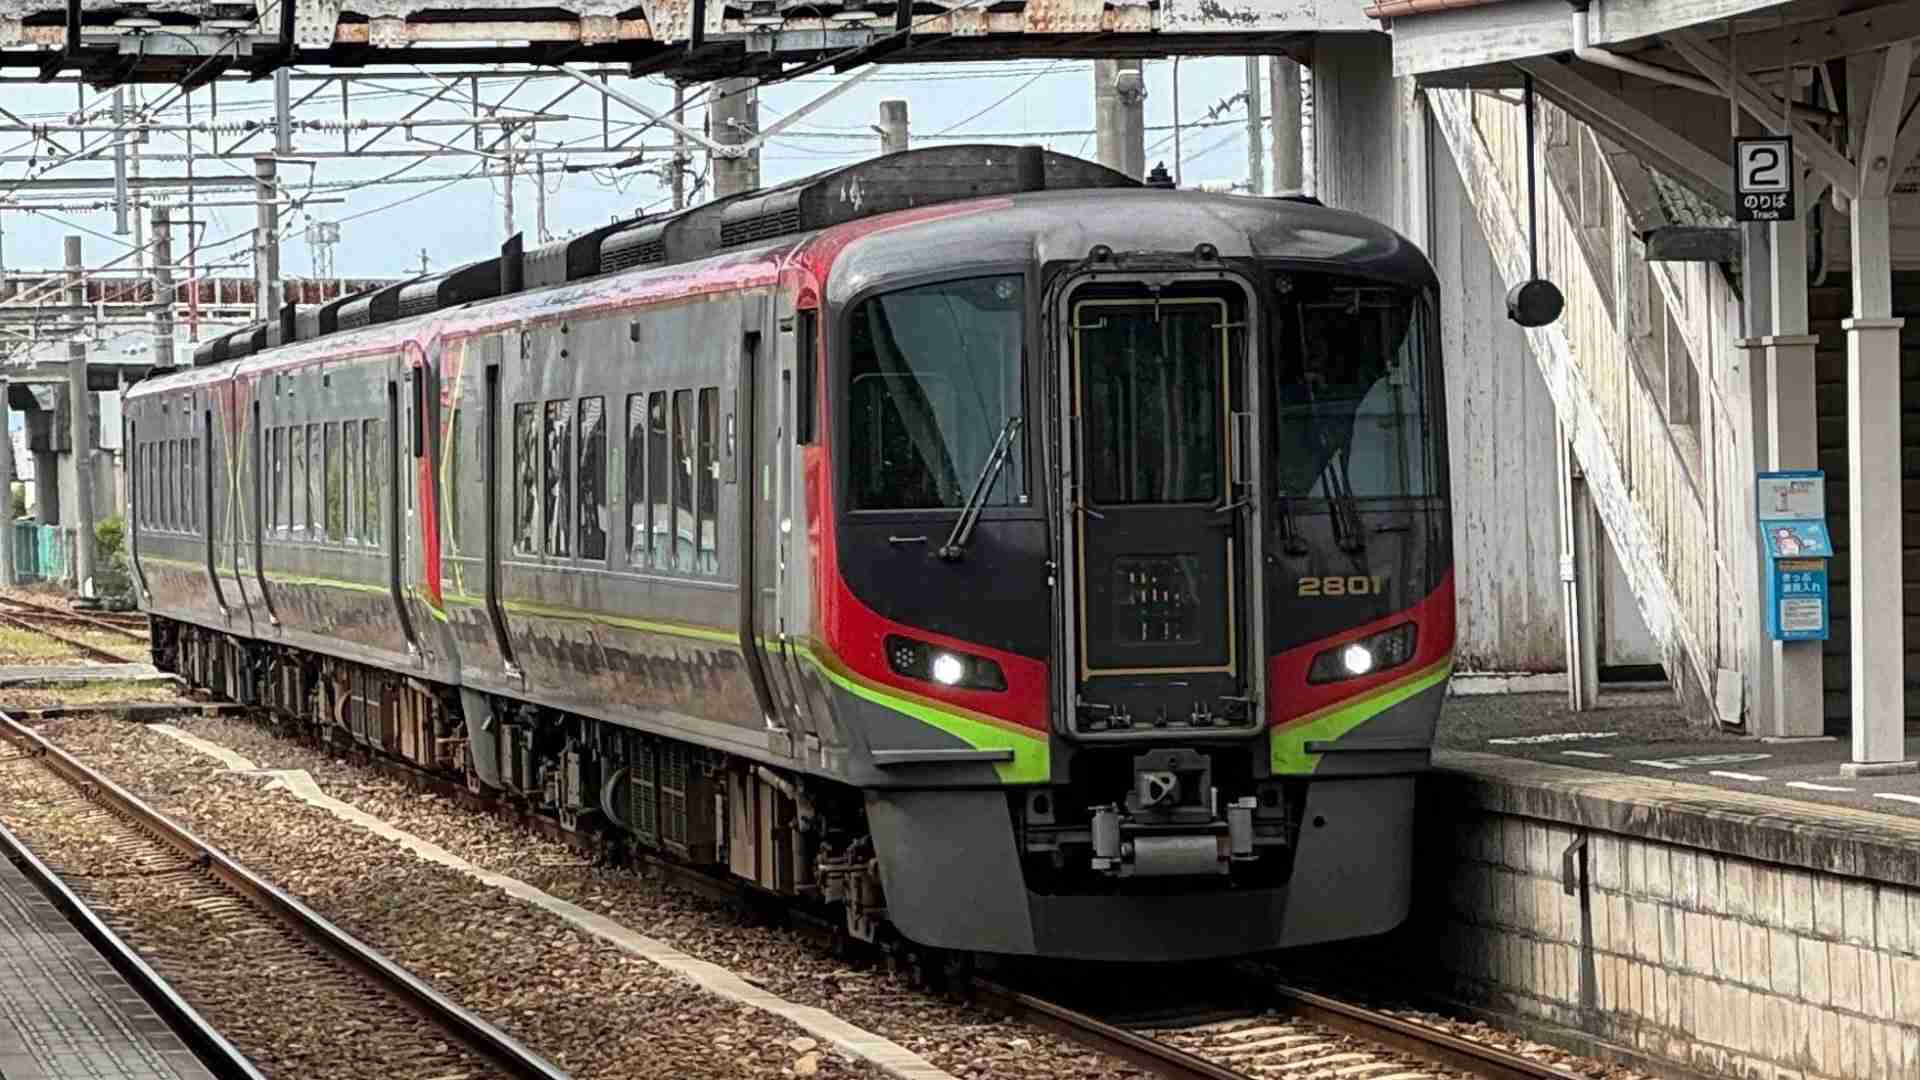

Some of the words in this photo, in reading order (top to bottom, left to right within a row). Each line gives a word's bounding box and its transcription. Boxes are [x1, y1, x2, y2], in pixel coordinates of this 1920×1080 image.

[1749, 148, 1779, 185] 2
[1744, 194, 1787, 209] のりば
[1752, 210, 1779, 219] Track
[1297, 576, 1381, 595] 2801
